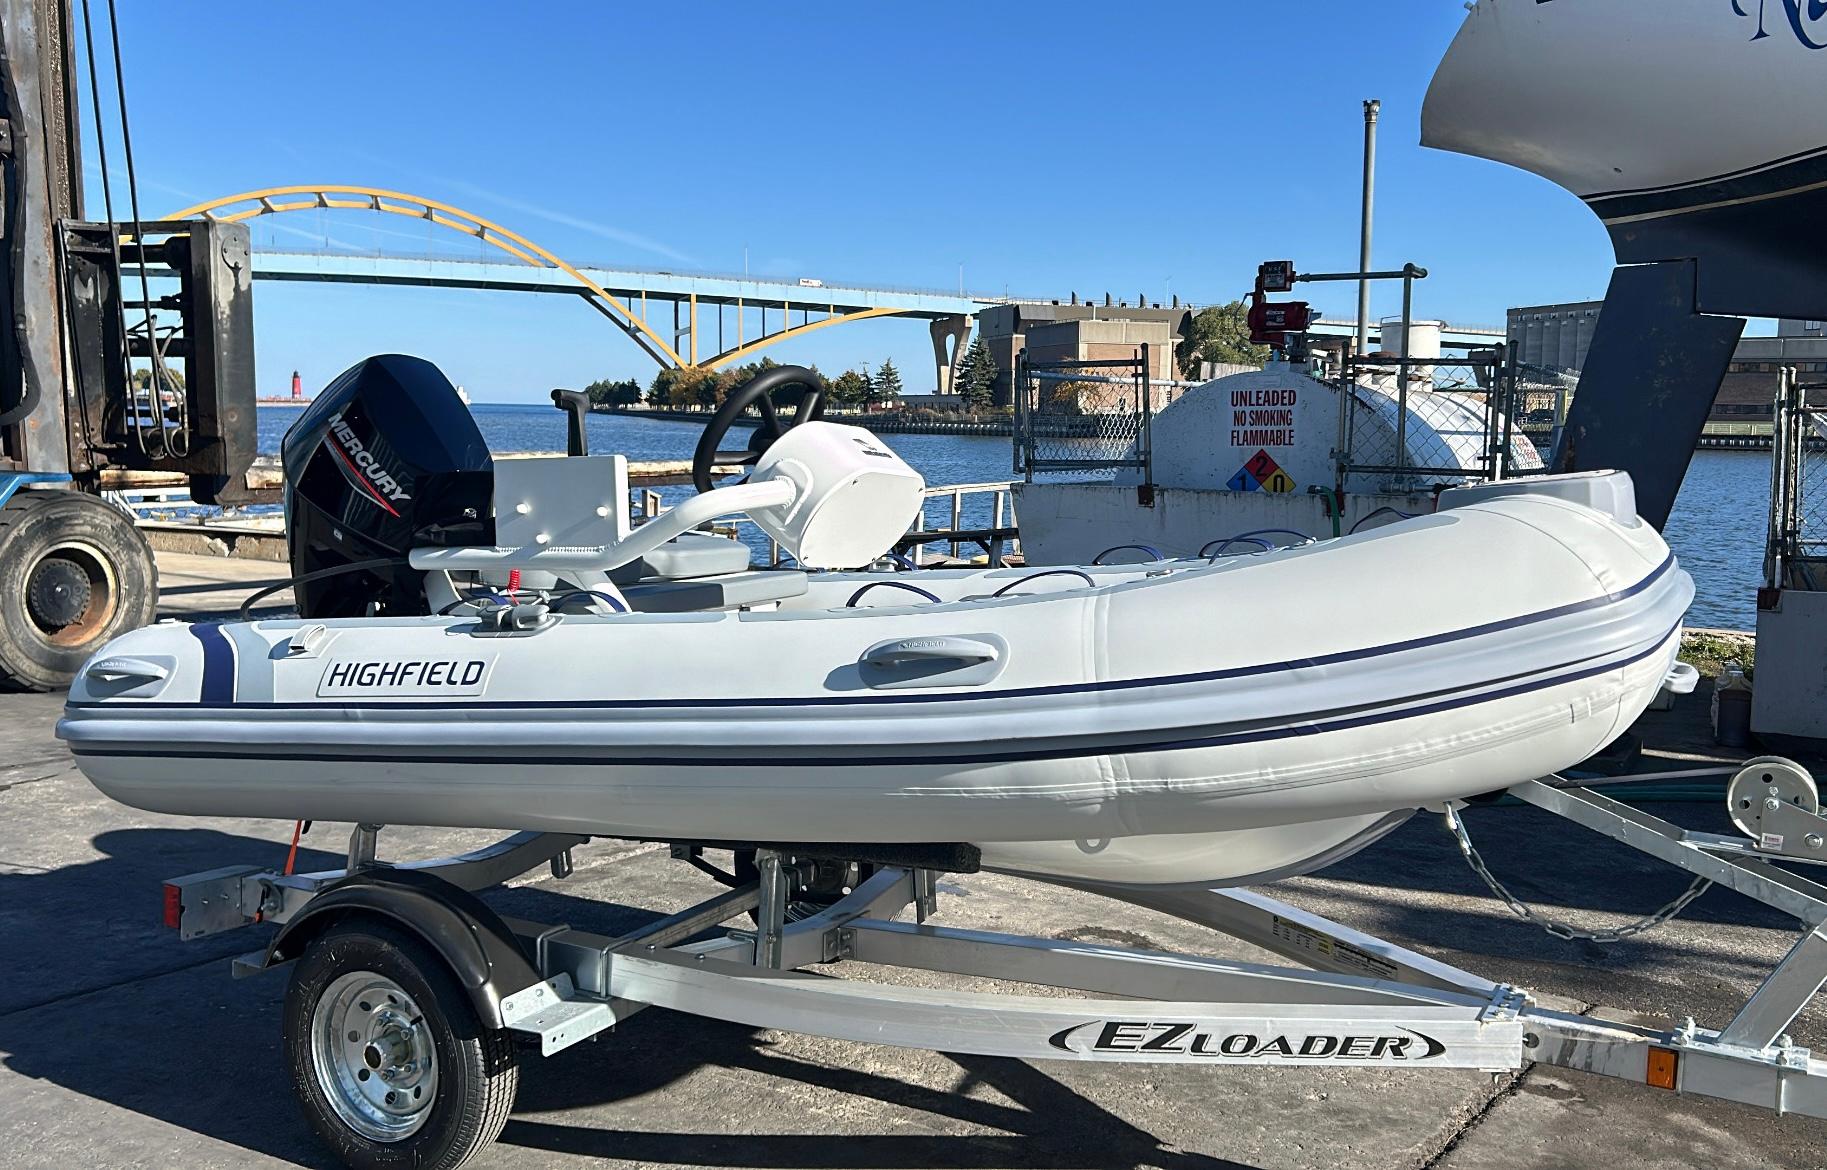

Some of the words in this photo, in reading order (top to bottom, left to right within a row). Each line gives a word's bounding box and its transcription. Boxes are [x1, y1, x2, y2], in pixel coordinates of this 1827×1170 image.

[1231, 390, 1296, 407] UNLEADED
[1233, 410, 1246, 426] NO
[1249, 410, 1293, 426] SMOKING
[1231, 430, 1294, 446] FLAMMABLE
[328, 413, 411, 500] MERCURY
[1255, 456, 1268, 477] 2
[1239, 474, 1247, 491] 1
[328, 661, 485, 686] HIGHFIELD
